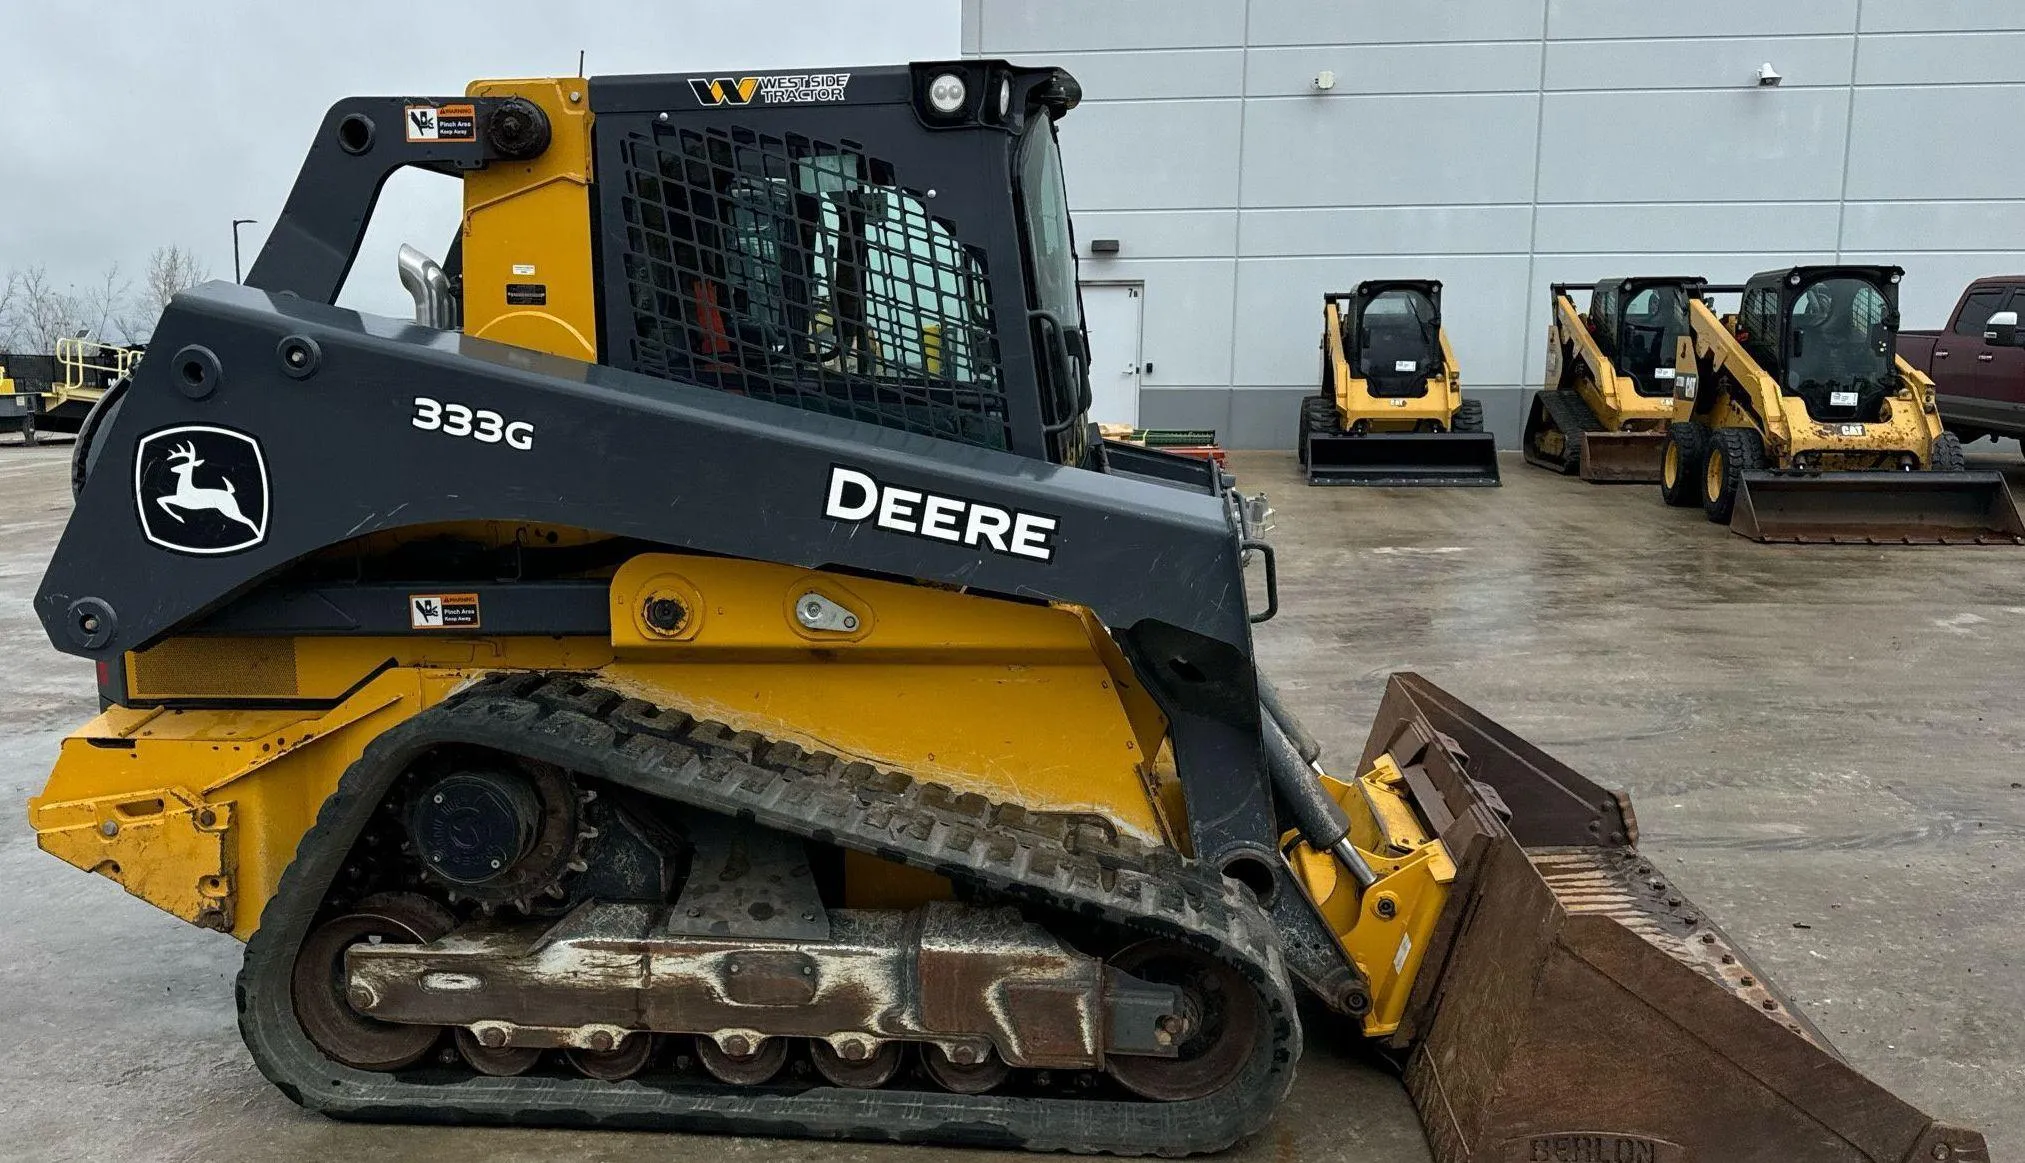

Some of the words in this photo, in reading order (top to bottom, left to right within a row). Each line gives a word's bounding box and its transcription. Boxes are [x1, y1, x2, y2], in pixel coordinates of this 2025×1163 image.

[760, 76, 807, 89] WEST
[810, 74, 848, 88] SIDE
[761, 88, 845, 103] TRACTOR
[411, 396, 535, 451] 333G
[1841, 425, 1863, 436] CAT
[824, 465, 1058, 561] DEERE
